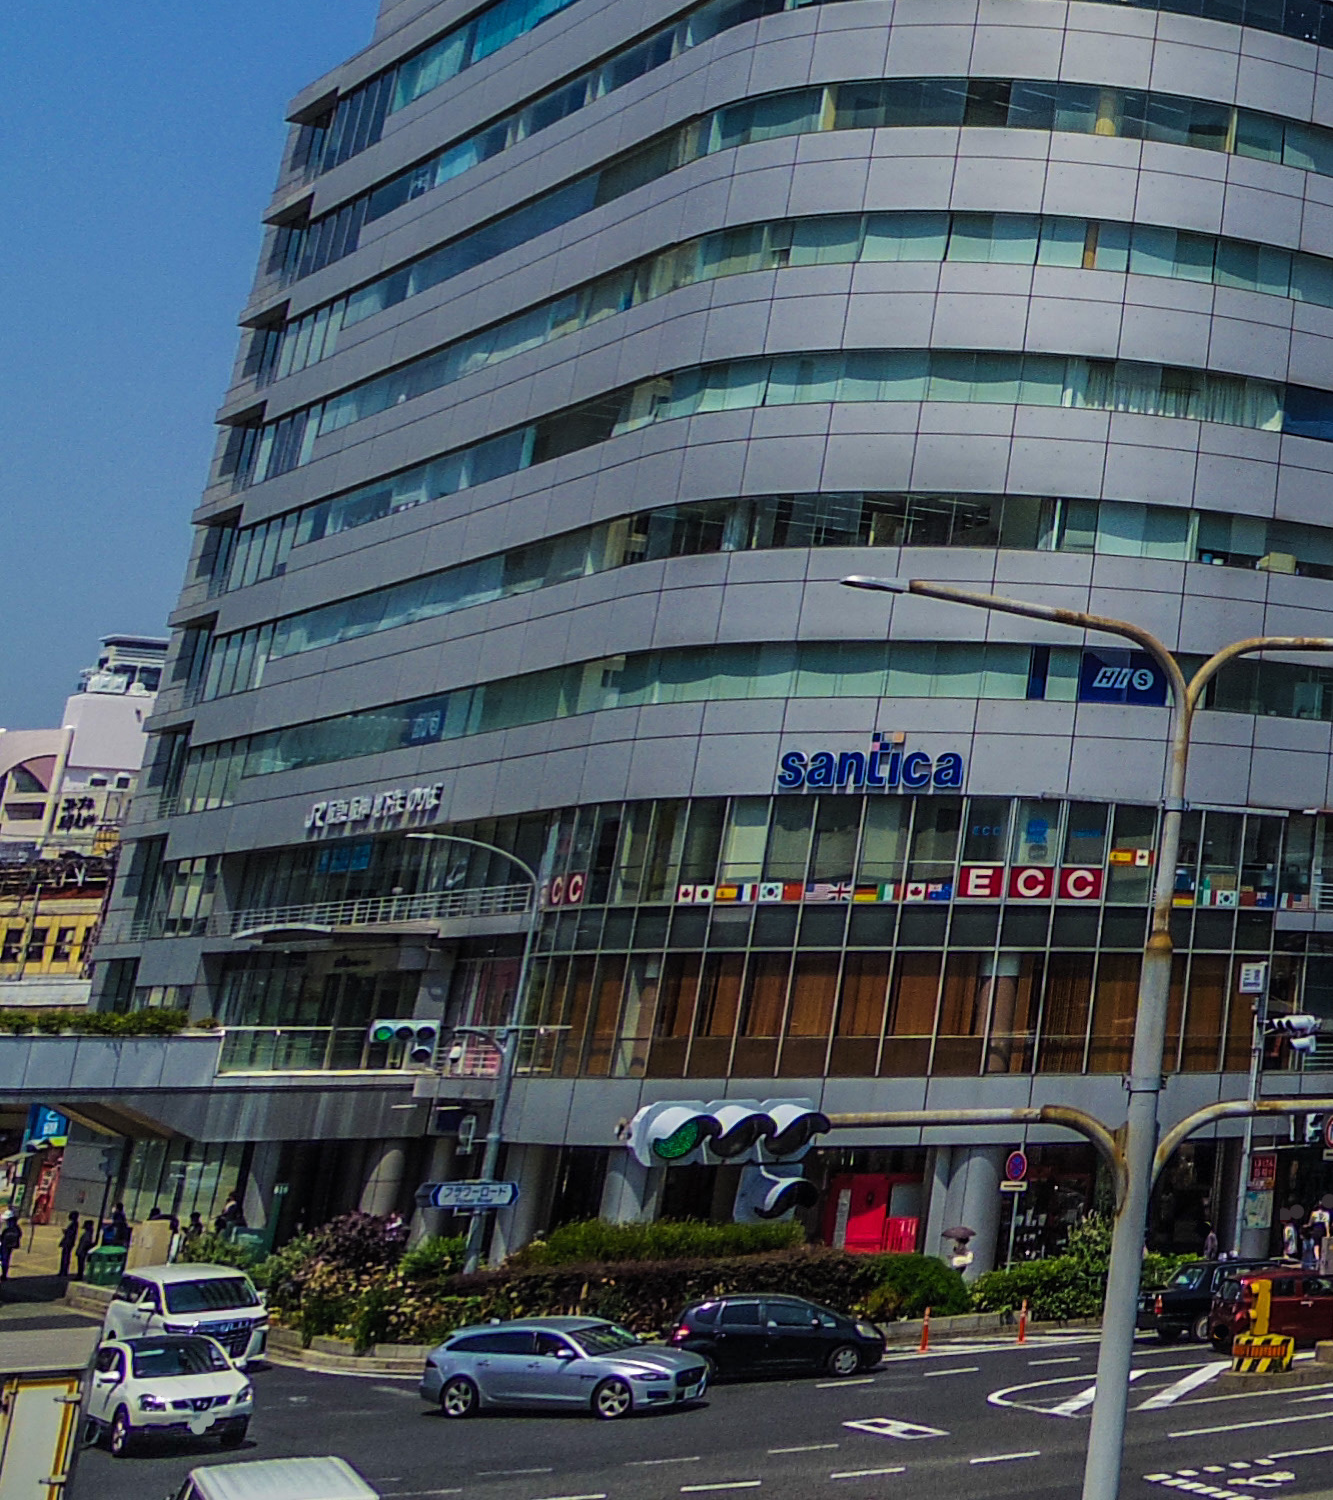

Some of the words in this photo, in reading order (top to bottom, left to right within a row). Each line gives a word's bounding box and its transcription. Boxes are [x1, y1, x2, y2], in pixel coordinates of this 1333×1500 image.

[777, 736, 964, 789] santica
[967, 868, 1095, 898] ECC
[444, 1186, 507, 1198] フラワーロード
